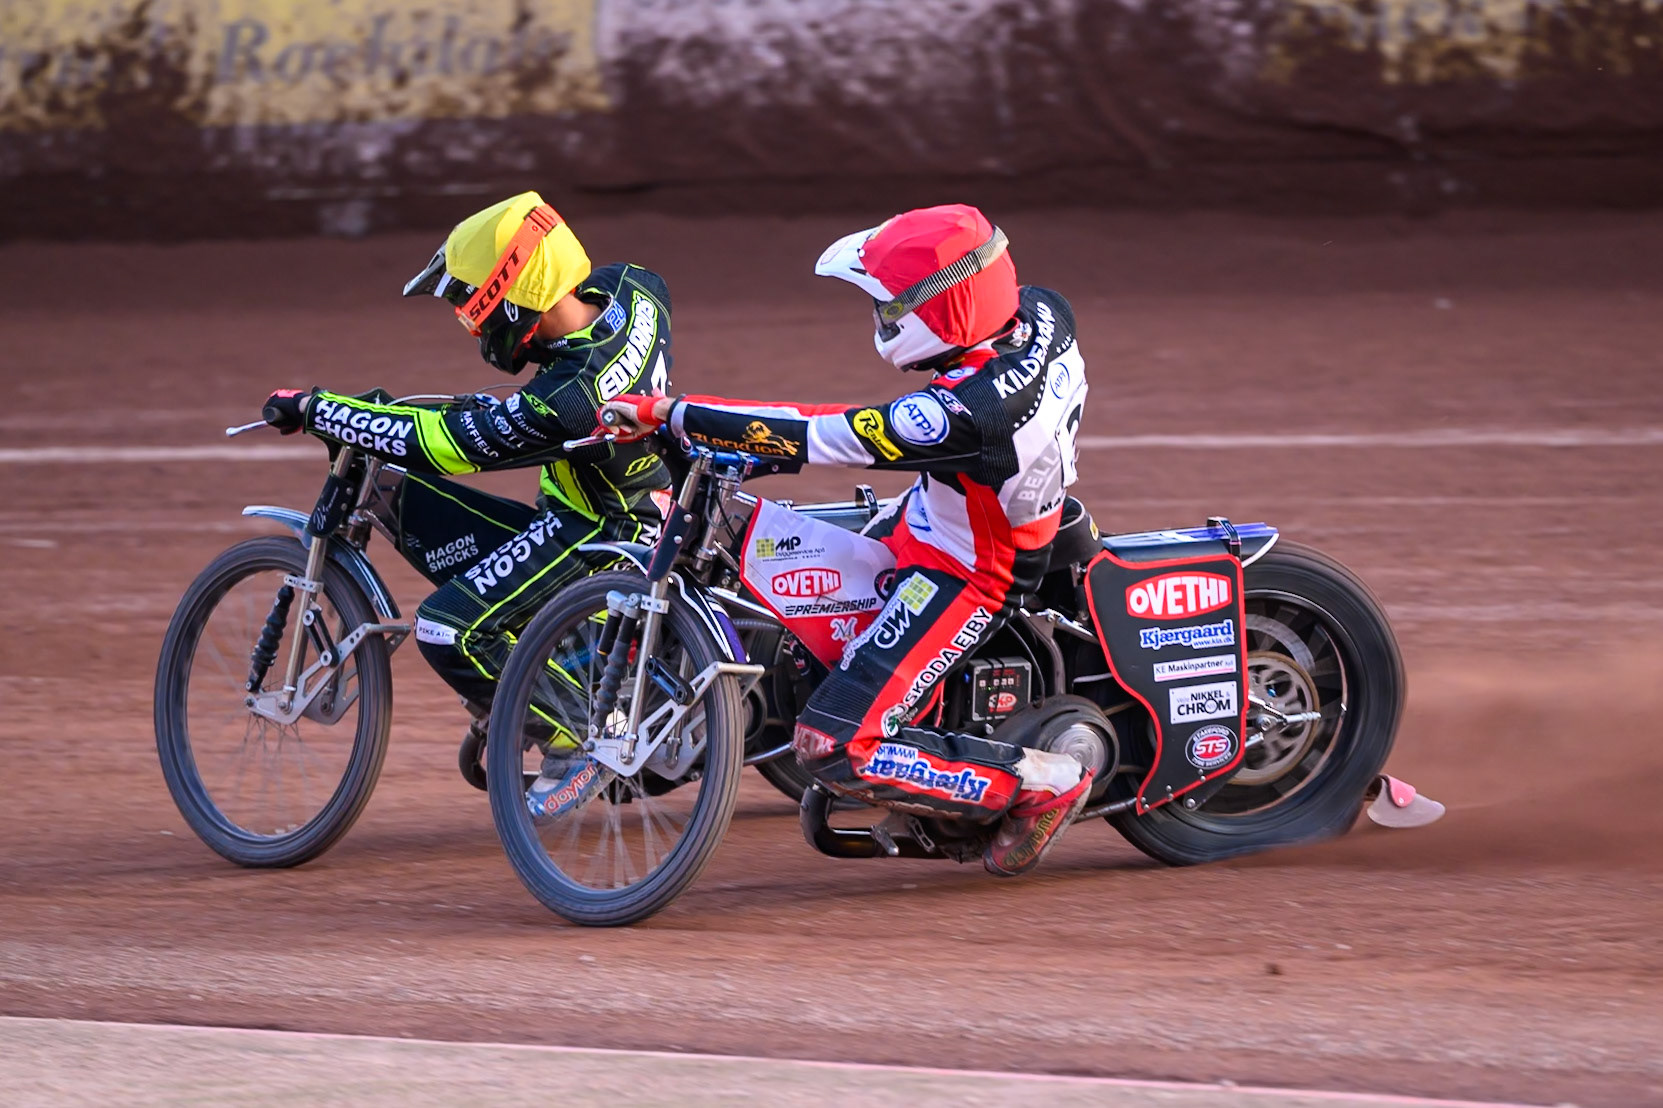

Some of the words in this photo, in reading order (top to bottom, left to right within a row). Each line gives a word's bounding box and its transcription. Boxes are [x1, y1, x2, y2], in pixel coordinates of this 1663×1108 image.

[469, 245, 519, 321] SCOTT
[597, 294, 656, 401] EDWARDS
[315, 399, 414, 439] HAGON
[902, 403, 936, 437] ATPI
[314, 415, 408, 457] SHOCKS
[1017, 454, 1061, 502] BELL
[425, 533, 475, 564] HAGON
[428, 545, 479, 573] SHOCKS
[473, 516, 563, 596] HAGON
[775, 536, 802, 551] MP
[774, 569, 840, 595] OVETHI
[1129, 575, 1229, 616] OVETHI
[785, 597, 877, 616] PREMIERSHIP
[1141, 621, 1232, 647] Kjærgaard
[904, 649, 959, 704] SKODA
[953, 607, 991, 648] EJBY
[1168, 659, 1223, 673] Maskinpartner
[1176, 697, 1231, 716] CHROM
[1190, 689, 1225, 701] NIKKEL
[1195, 738, 1228, 756] STS
